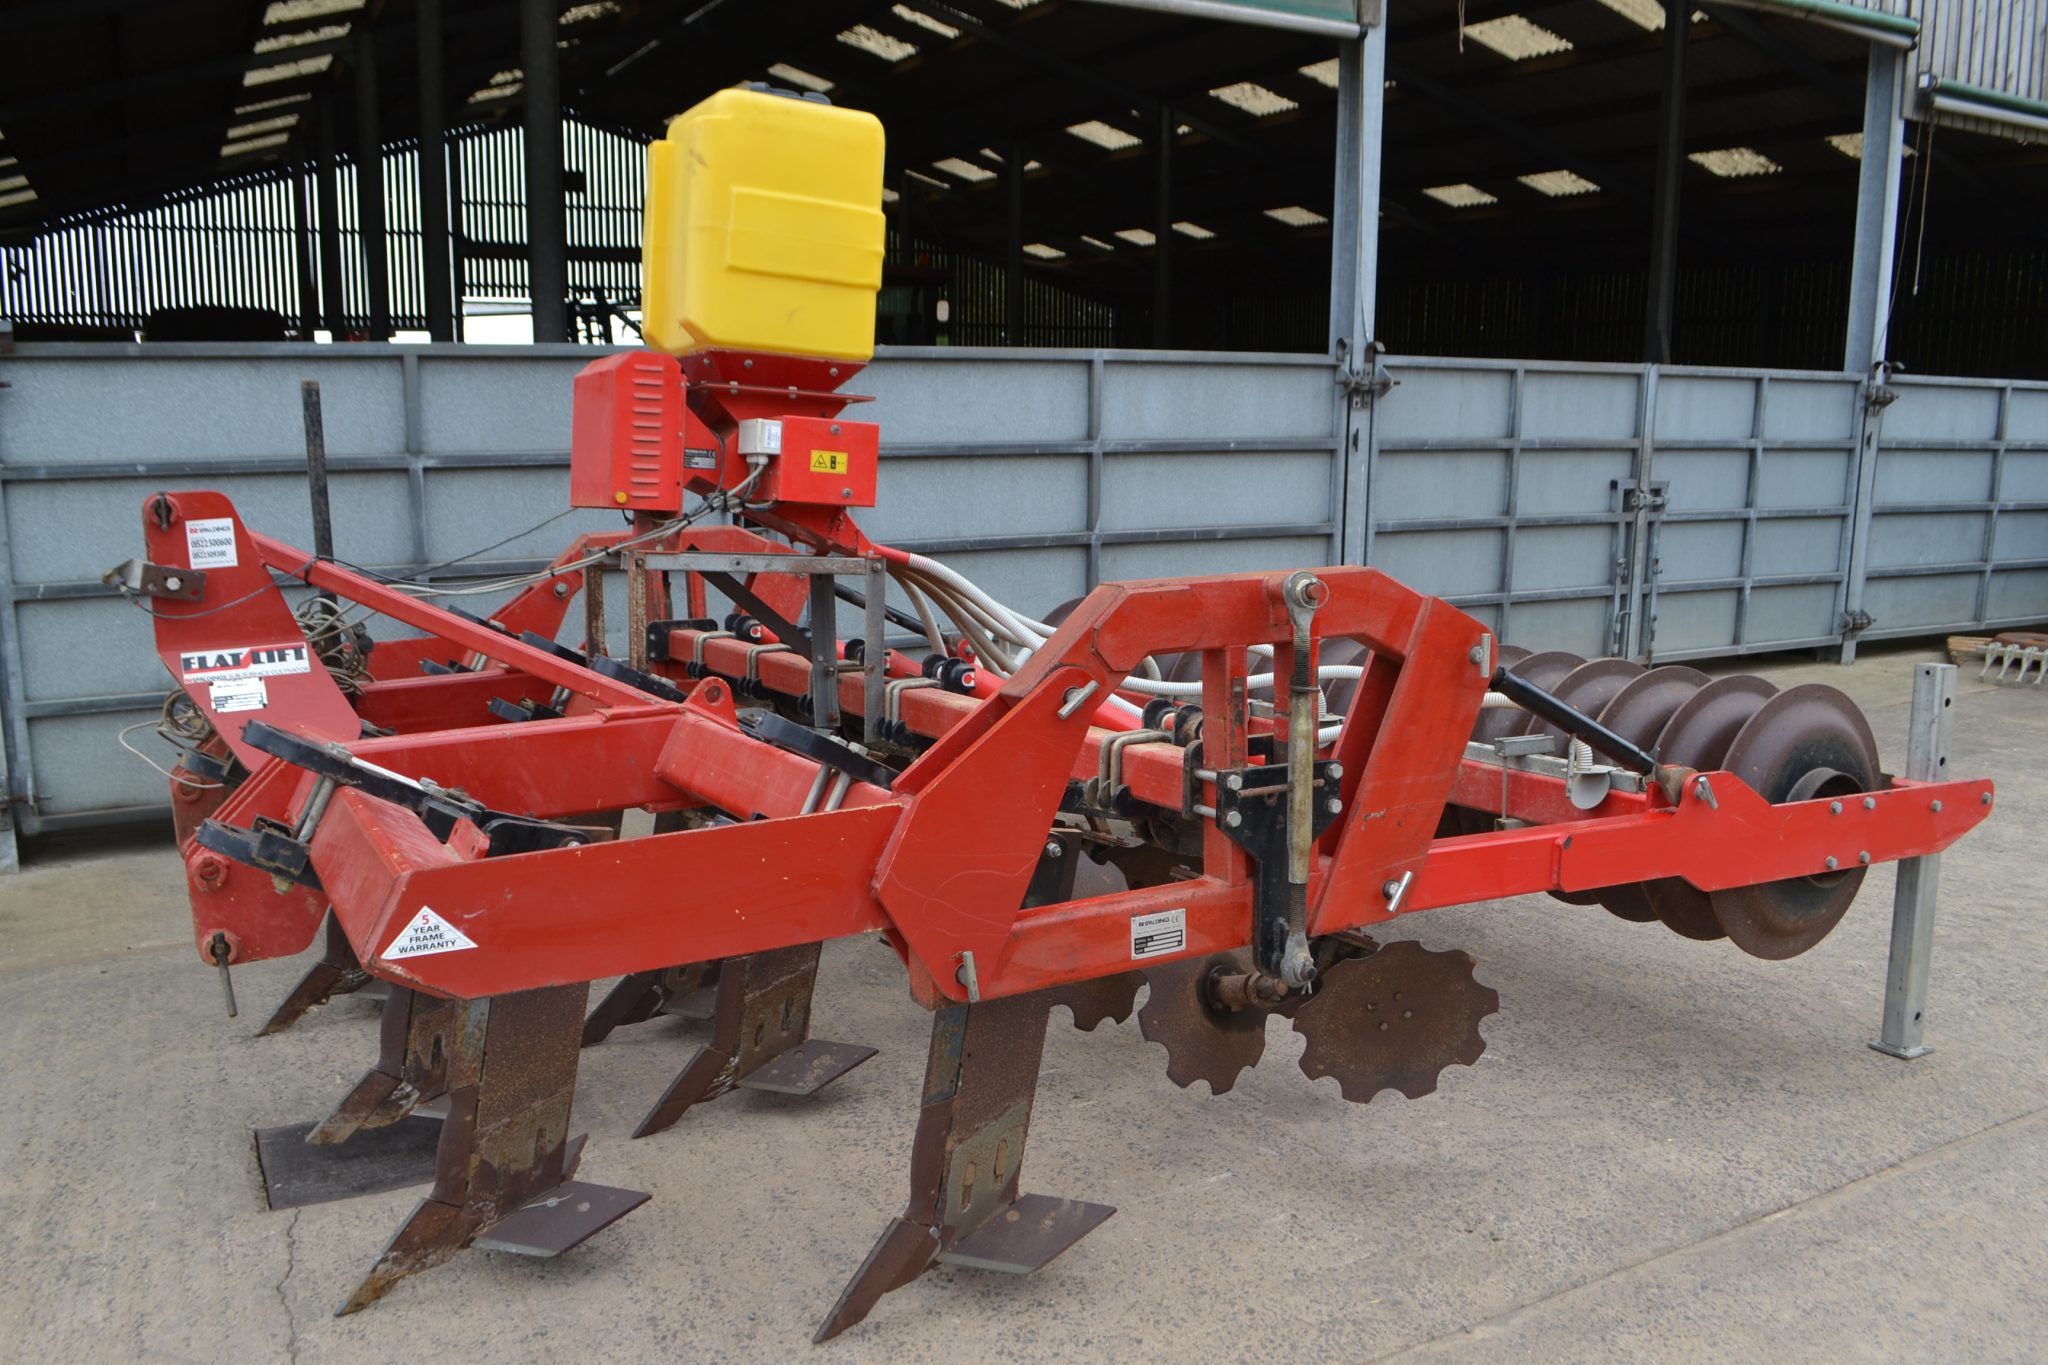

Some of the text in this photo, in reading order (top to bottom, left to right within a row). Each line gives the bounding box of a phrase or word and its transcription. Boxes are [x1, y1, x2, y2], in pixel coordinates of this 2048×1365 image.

[182, 648, 304, 670] FLAT LIFT
[422, 915, 429, 925] 5
[1145, 917, 1170, 926] SPALDINGS
[413, 925, 440, 934] YEAR
[409, 933, 445, 944] FRAME
[399, 940, 456, 953] WARRANTY
